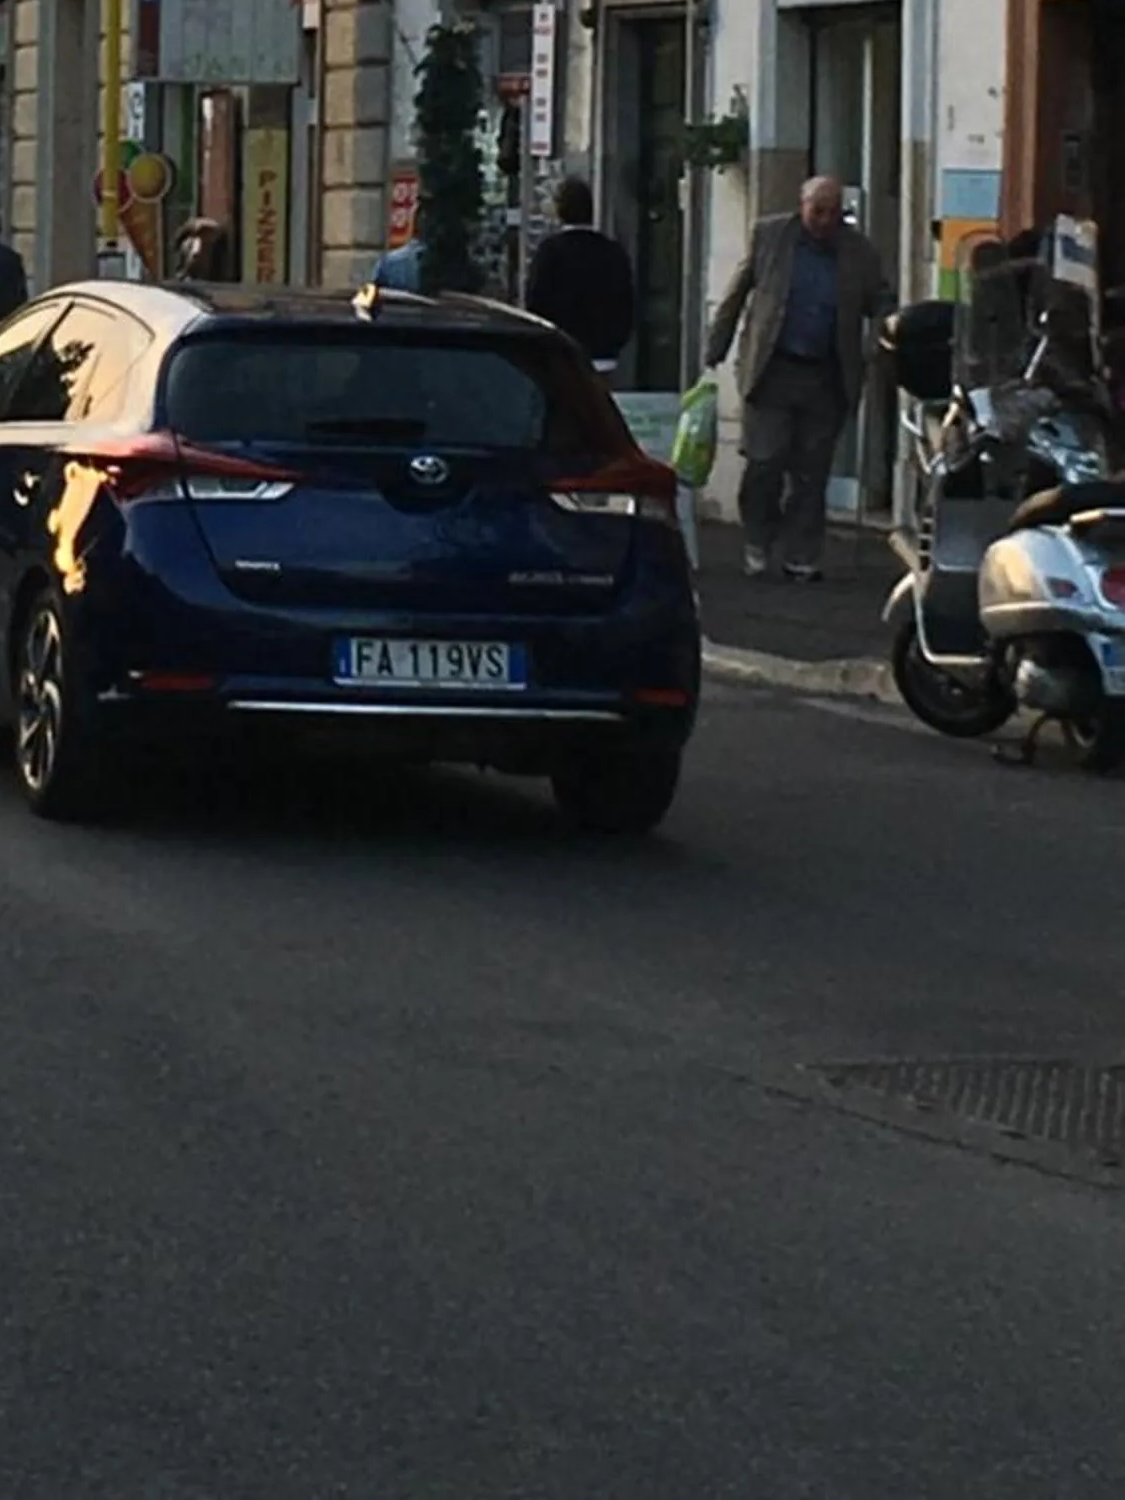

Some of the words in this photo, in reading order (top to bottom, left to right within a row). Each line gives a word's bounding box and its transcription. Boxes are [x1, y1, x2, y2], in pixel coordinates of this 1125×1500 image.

[257, 169, 278, 284] PIZZER
[355, 640, 394, 677] FA
[409, 643, 505, 680] 119VS
